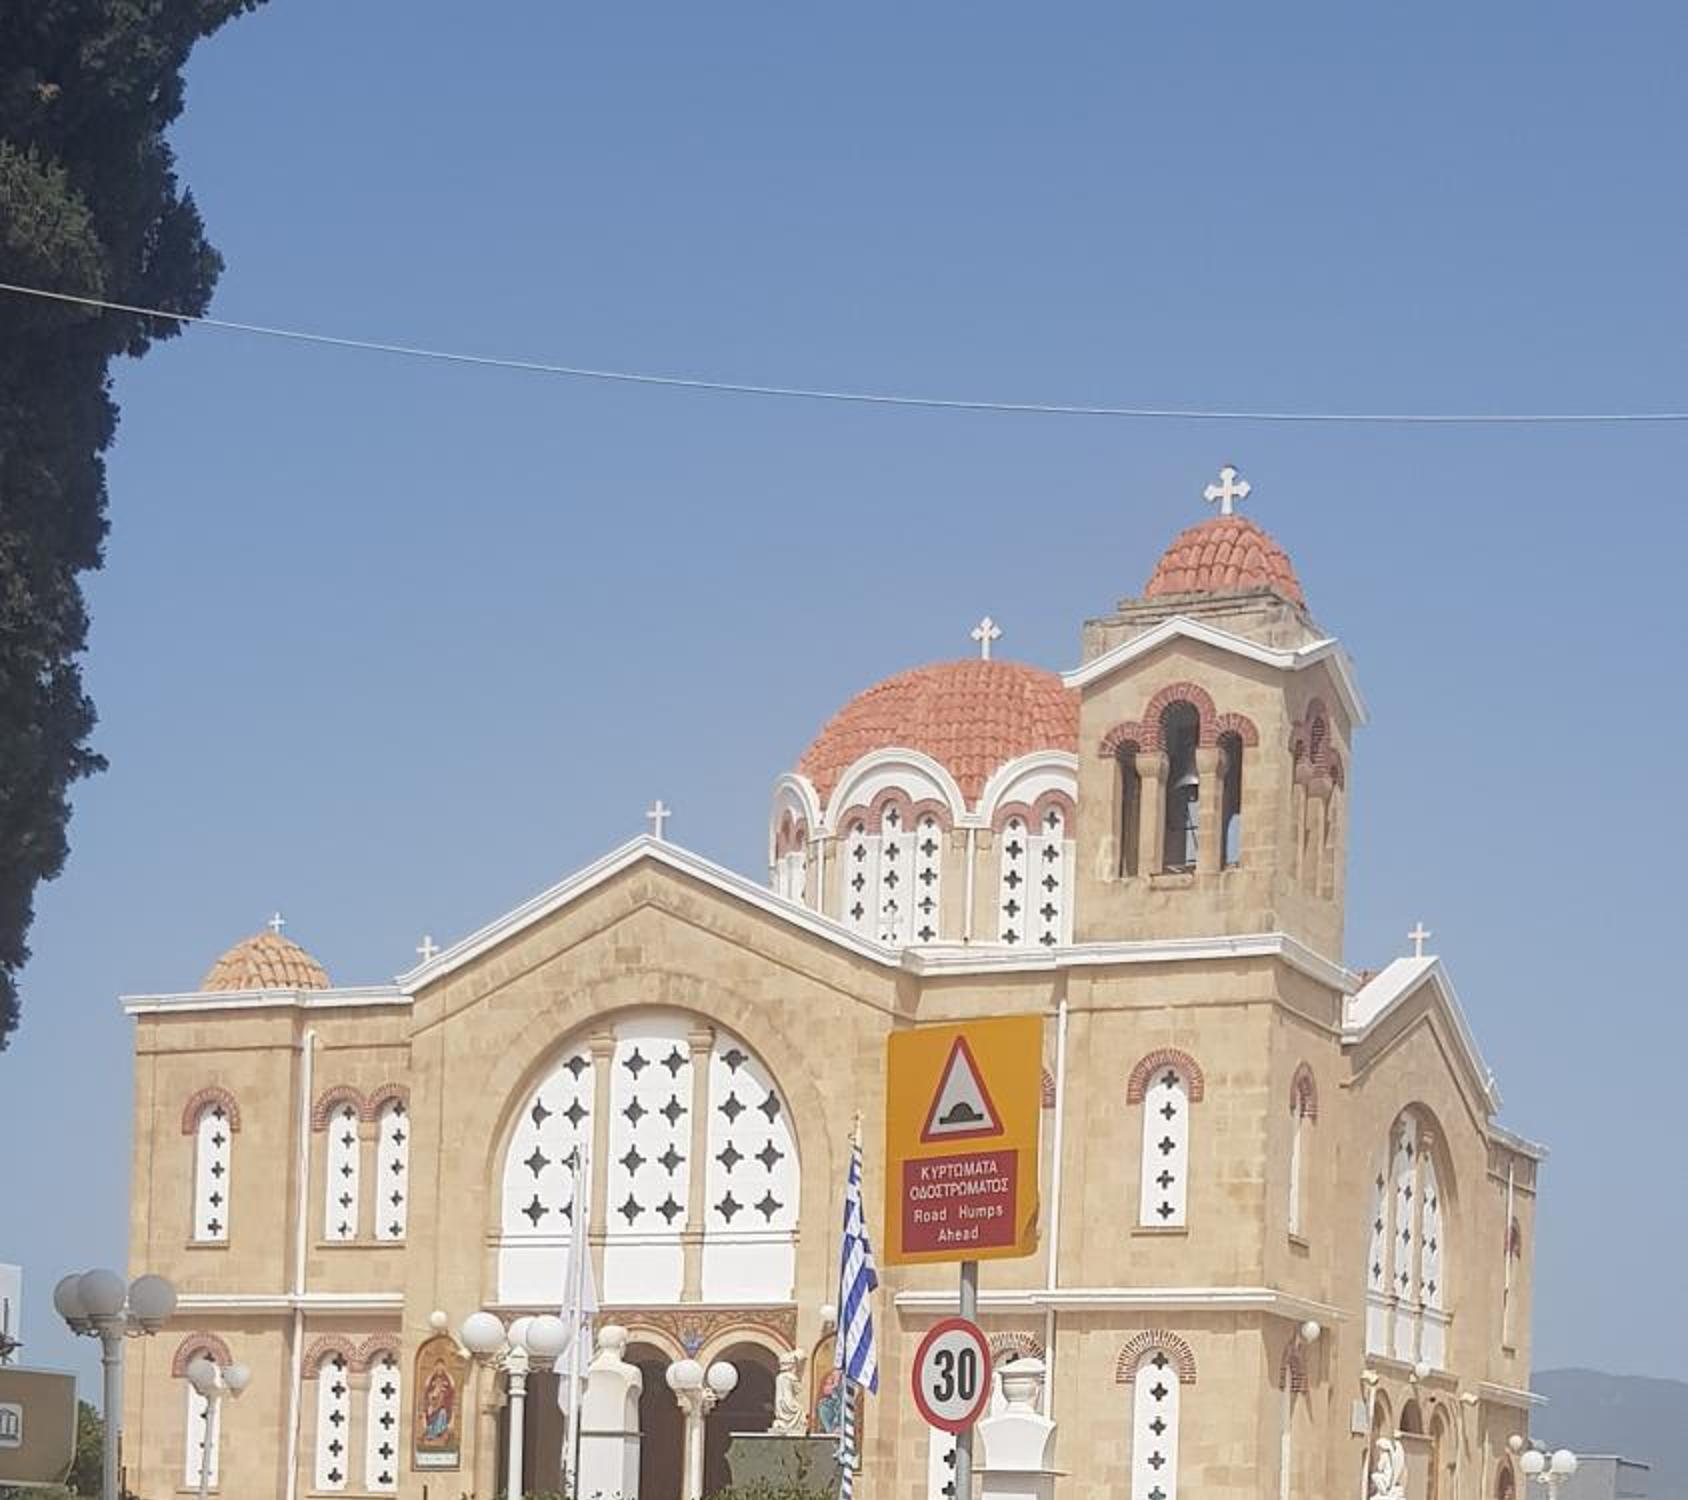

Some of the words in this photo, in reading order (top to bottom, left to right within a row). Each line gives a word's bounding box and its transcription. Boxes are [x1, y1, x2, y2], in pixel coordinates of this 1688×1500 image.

[914, 1207, 947, 1223] Road
[959, 1204, 1003, 1220] Humps
[938, 1225, 979, 1242] Ahead
[933, 1347, 977, 1403] 30
